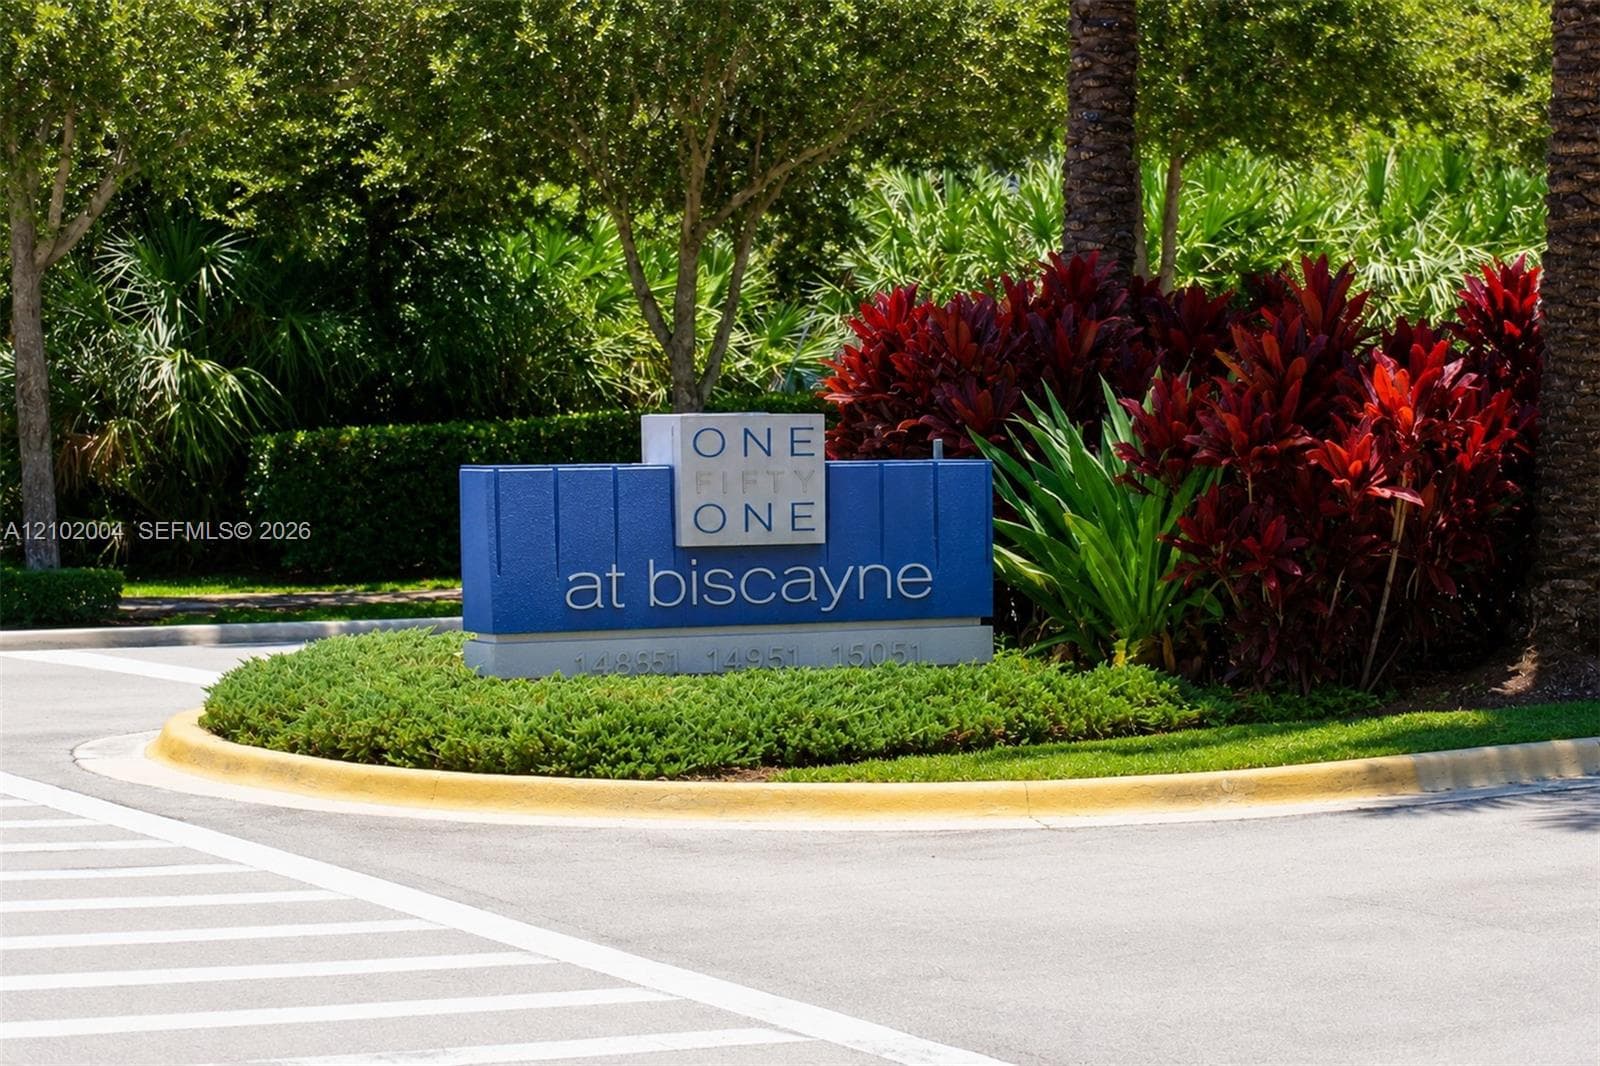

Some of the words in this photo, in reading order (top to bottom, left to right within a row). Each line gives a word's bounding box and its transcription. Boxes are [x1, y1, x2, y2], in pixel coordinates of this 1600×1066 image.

[692, 427, 815, 458] ONE
[695, 469, 816, 495] FIFTY
[693, 502, 816, 534] ONE
[565, 564, 626, 610] at
[648, 559, 933, 612] biscayne
[706, 646, 799, 672] 14951
[831, 640, 923, 667] 15051
